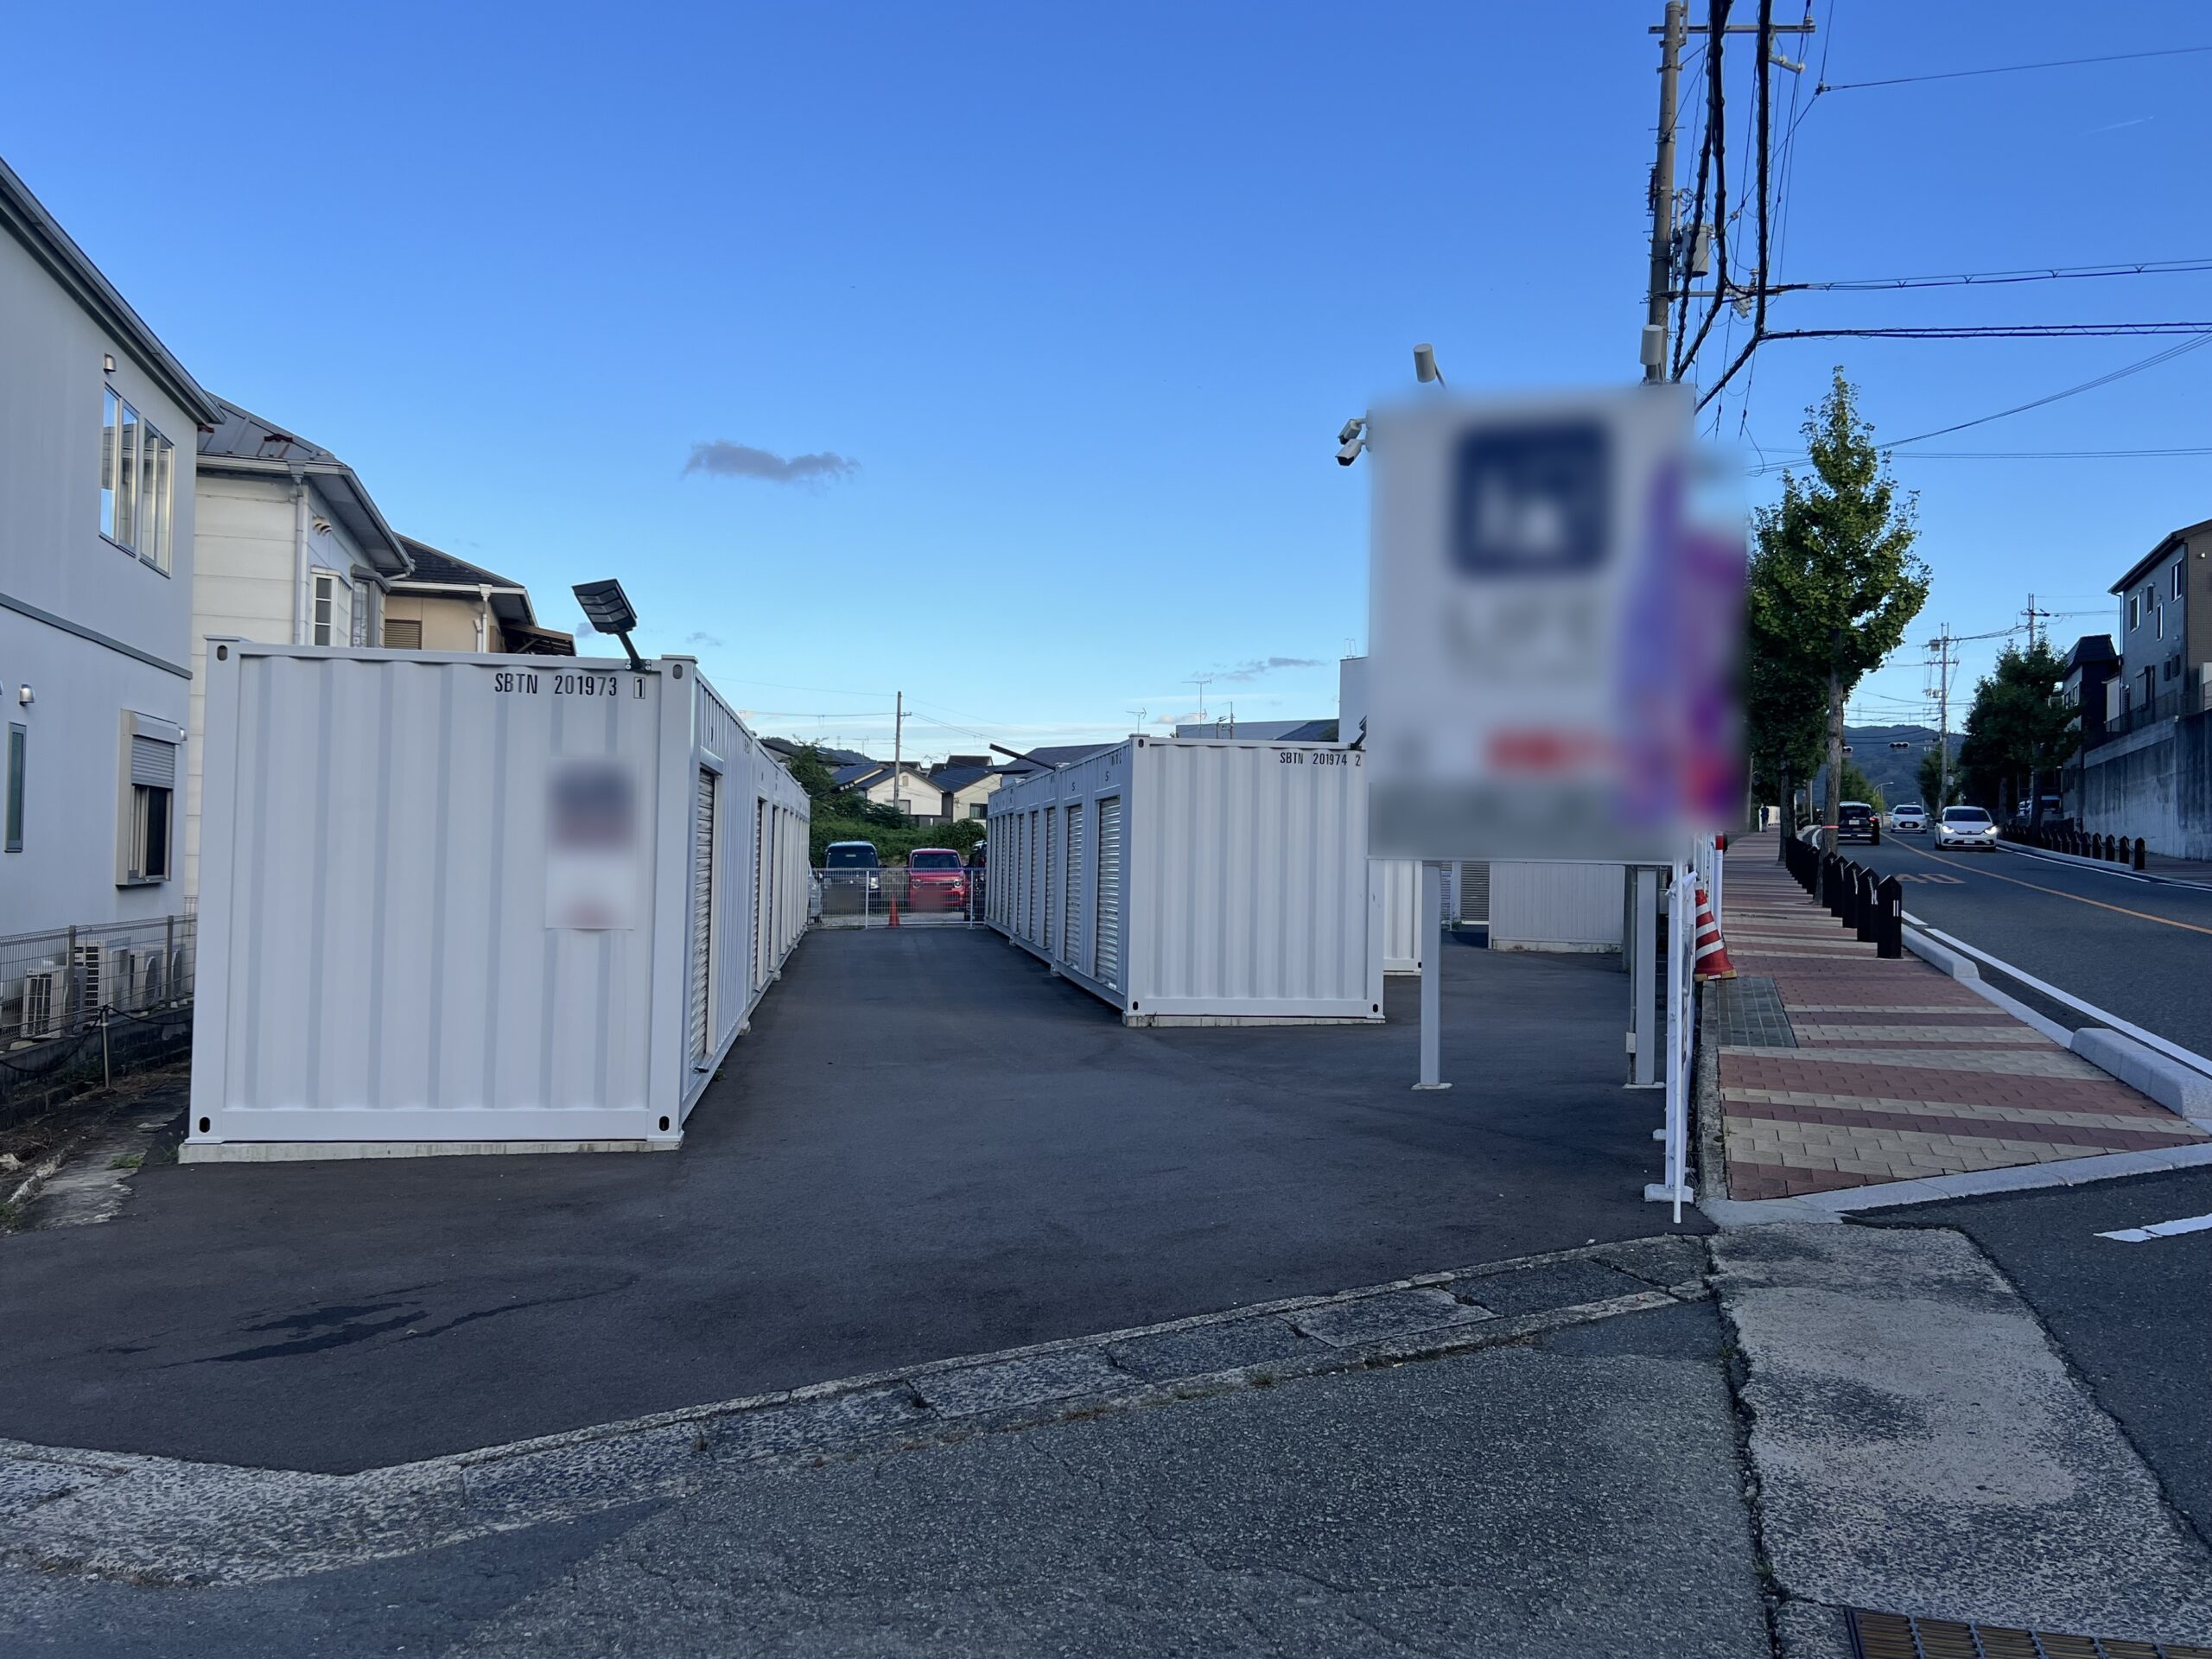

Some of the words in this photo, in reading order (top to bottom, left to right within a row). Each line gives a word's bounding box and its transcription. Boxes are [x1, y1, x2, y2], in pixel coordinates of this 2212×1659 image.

[494, 673, 537, 694] SBTN
[555, 675, 617, 696] 201973
[635, 677, 645, 698] 1
[1280, 752, 1303, 764] SBTN
[1313, 753, 1347, 766] 201974
[1355, 754, 1361, 766] 2
